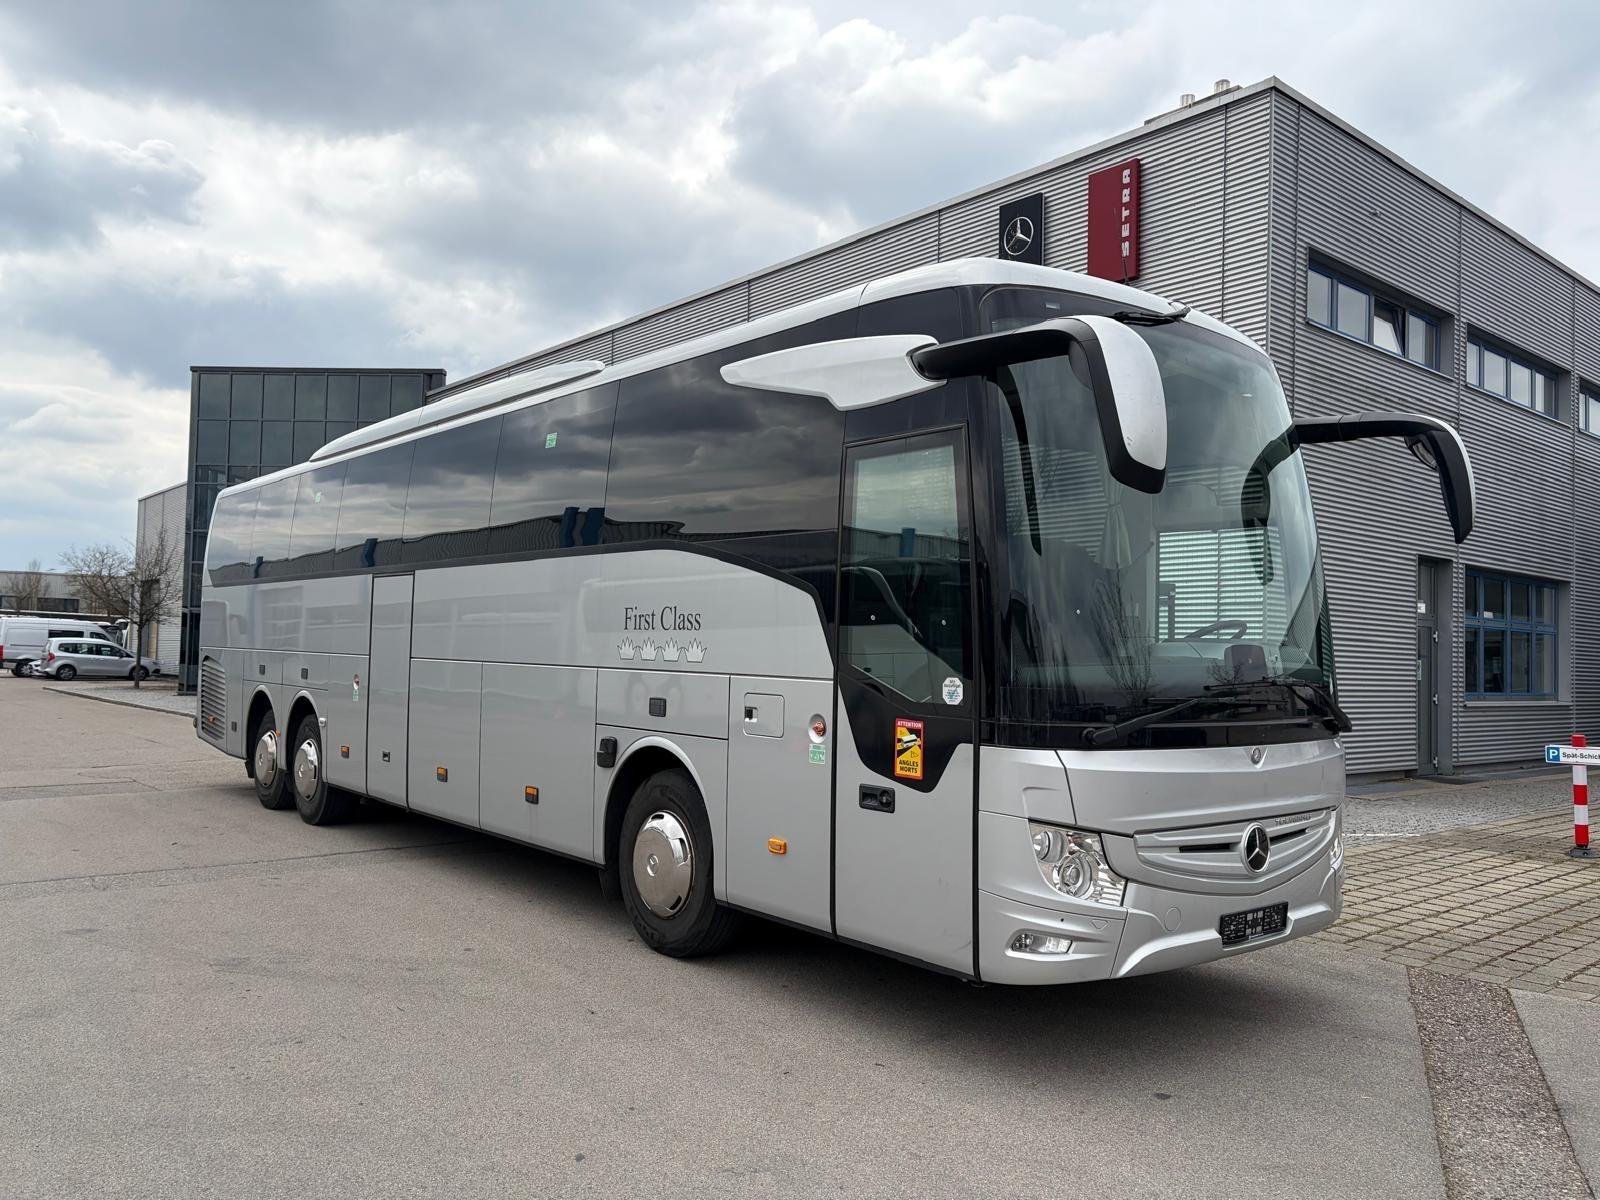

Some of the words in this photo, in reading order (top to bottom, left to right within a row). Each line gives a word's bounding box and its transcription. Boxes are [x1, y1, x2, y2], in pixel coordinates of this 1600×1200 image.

[1121, 168, 1131, 257] SETRA
[623, 606, 656, 631] First
[660, 605, 702, 631] Class
[897, 720, 922, 728] ATTENTION
[1549, 749, 1558, 760] P
[899, 759, 919, 768] ANGLES
[899, 765, 918, 774] MORTS
